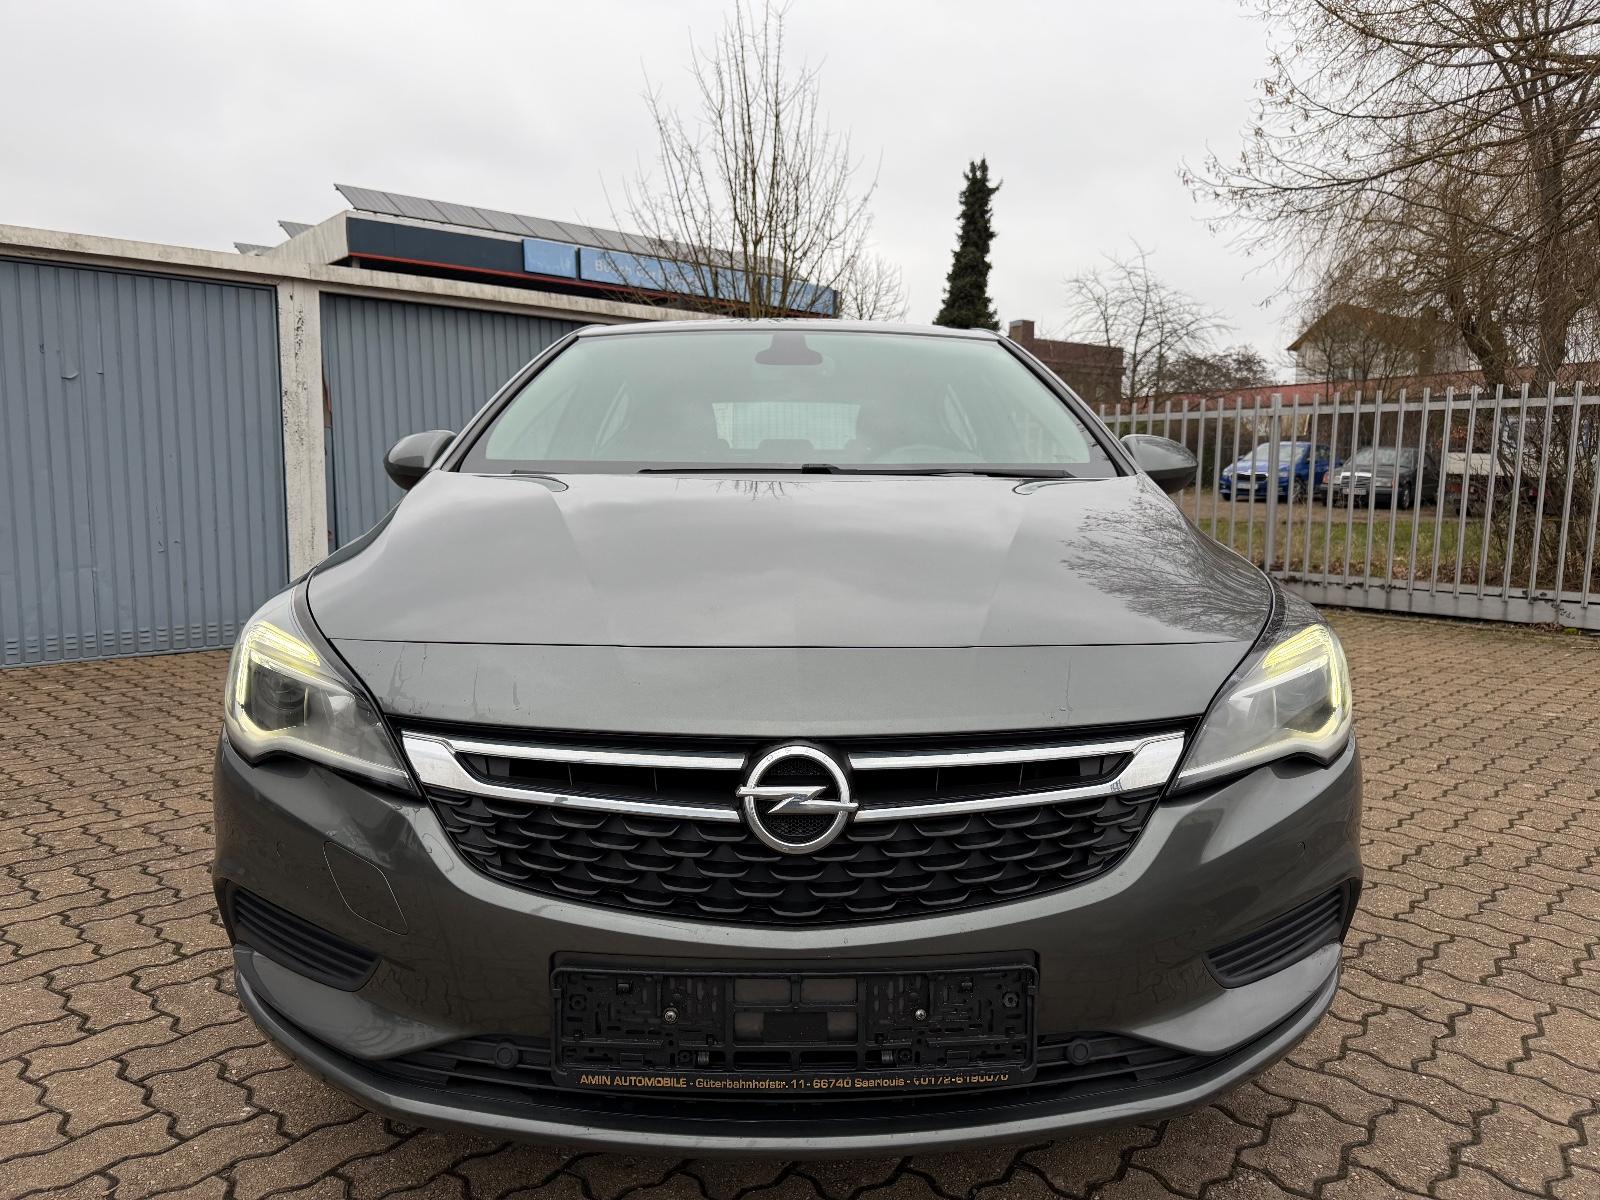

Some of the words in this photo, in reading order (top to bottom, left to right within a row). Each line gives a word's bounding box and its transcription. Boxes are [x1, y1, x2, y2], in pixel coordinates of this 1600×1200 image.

[580, 1074, 611, 1085] AMIN
[614, 1075, 687, 1088] AUTOMOBILE
[696, 1078, 789, 1089] Güterbahnhofstr.
[791, 1079, 805, 1089] 11
[812, 1078, 852, 1089] 66740
[854, 1077, 905, 1088] Saarlouis
